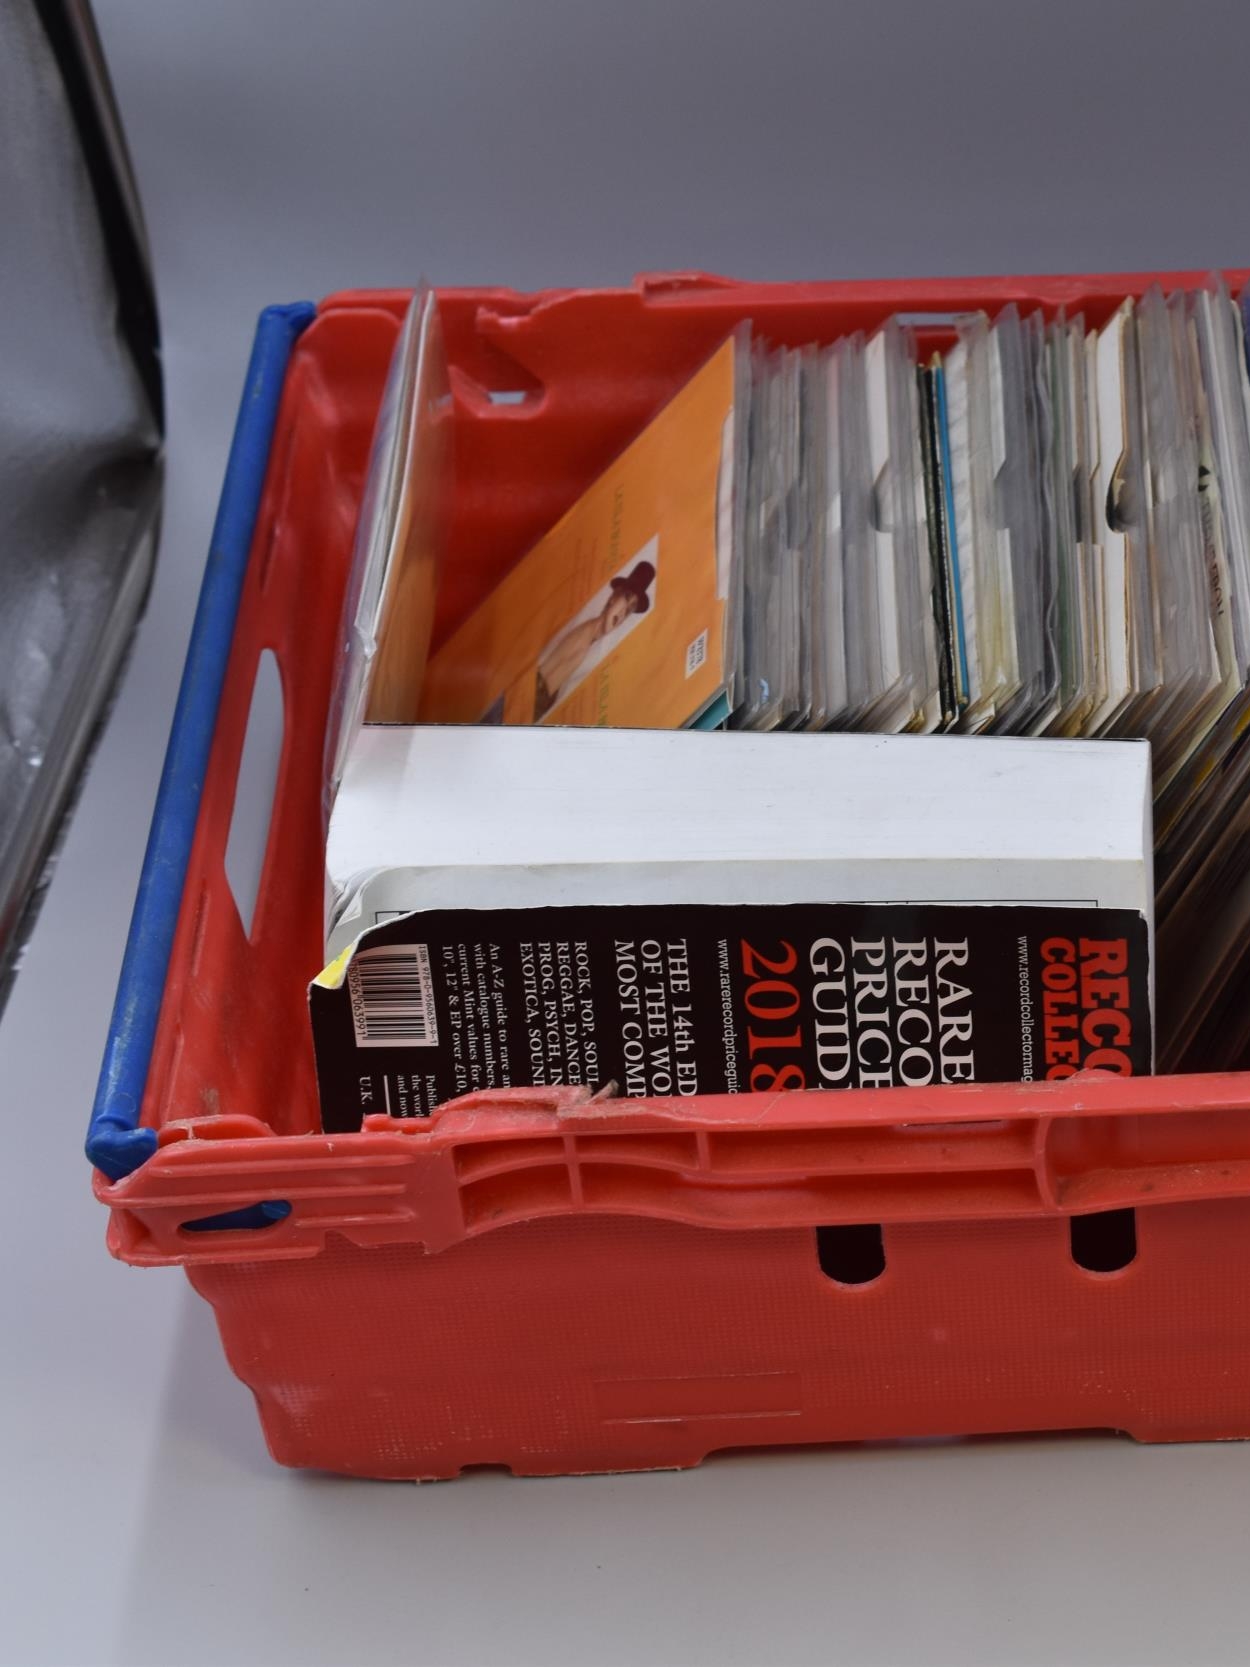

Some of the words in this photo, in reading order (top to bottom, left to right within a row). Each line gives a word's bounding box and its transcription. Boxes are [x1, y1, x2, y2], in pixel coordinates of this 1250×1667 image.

[418, 946, 428, 963] ISBN
[457, 944, 473, 986] current
[473, 944, 488, 969] with
[489, 943, 501, 959] An
[536, 942, 554, 996] PROG,
[574, 941, 590, 994] ROCK,
[641, 939, 663, 976] OF
[666, 939, 691, 994] THE
[492, 964, 505, 988] A-Z
[518, 942, 539, 1024] EXOTICA,
[556, 942, 575, 1017] REGGAE,
[615, 940, 640, 1014] MOST
[353, 999, 366, 1035] 063991
[449, 995, 462, 1006] &
[463, 990, 477, 1019] Mint
[475, 973, 495, 1029] catalogue
[492, 992, 508, 1025] guide
[578, 998, 594, 1036] POP,
[644, 983, 667, 1038] THE
[740, 939, 805, 1094] 2018
[810, 937, 850, 1091] GUID
[892, 937, 934, 1087] RECO
[934, 937, 975, 1083] RARE
[451, 1010, 464, 1029] EP
[497, 1029, 509, 1042] to
[541, 1000, 560, 1062] PSYCH,
[671, 1003, 695, 1052] 14th
[452, 1033, 465, 1060] over
[466, 1024, 481, 1060] values
[499, 1046, 511, 1070] rare
[564, 1023, 582, 1086] DANCE
[359, 1076, 373, 1105] U.K.
[397, 1075, 410, 1094] and
[411, 1075, 424, 1092] the
[453, 1063, 469, 1093] £10,
[469, 1065, 482, 1083] for
[650, 1046, 671, 1098] WO
